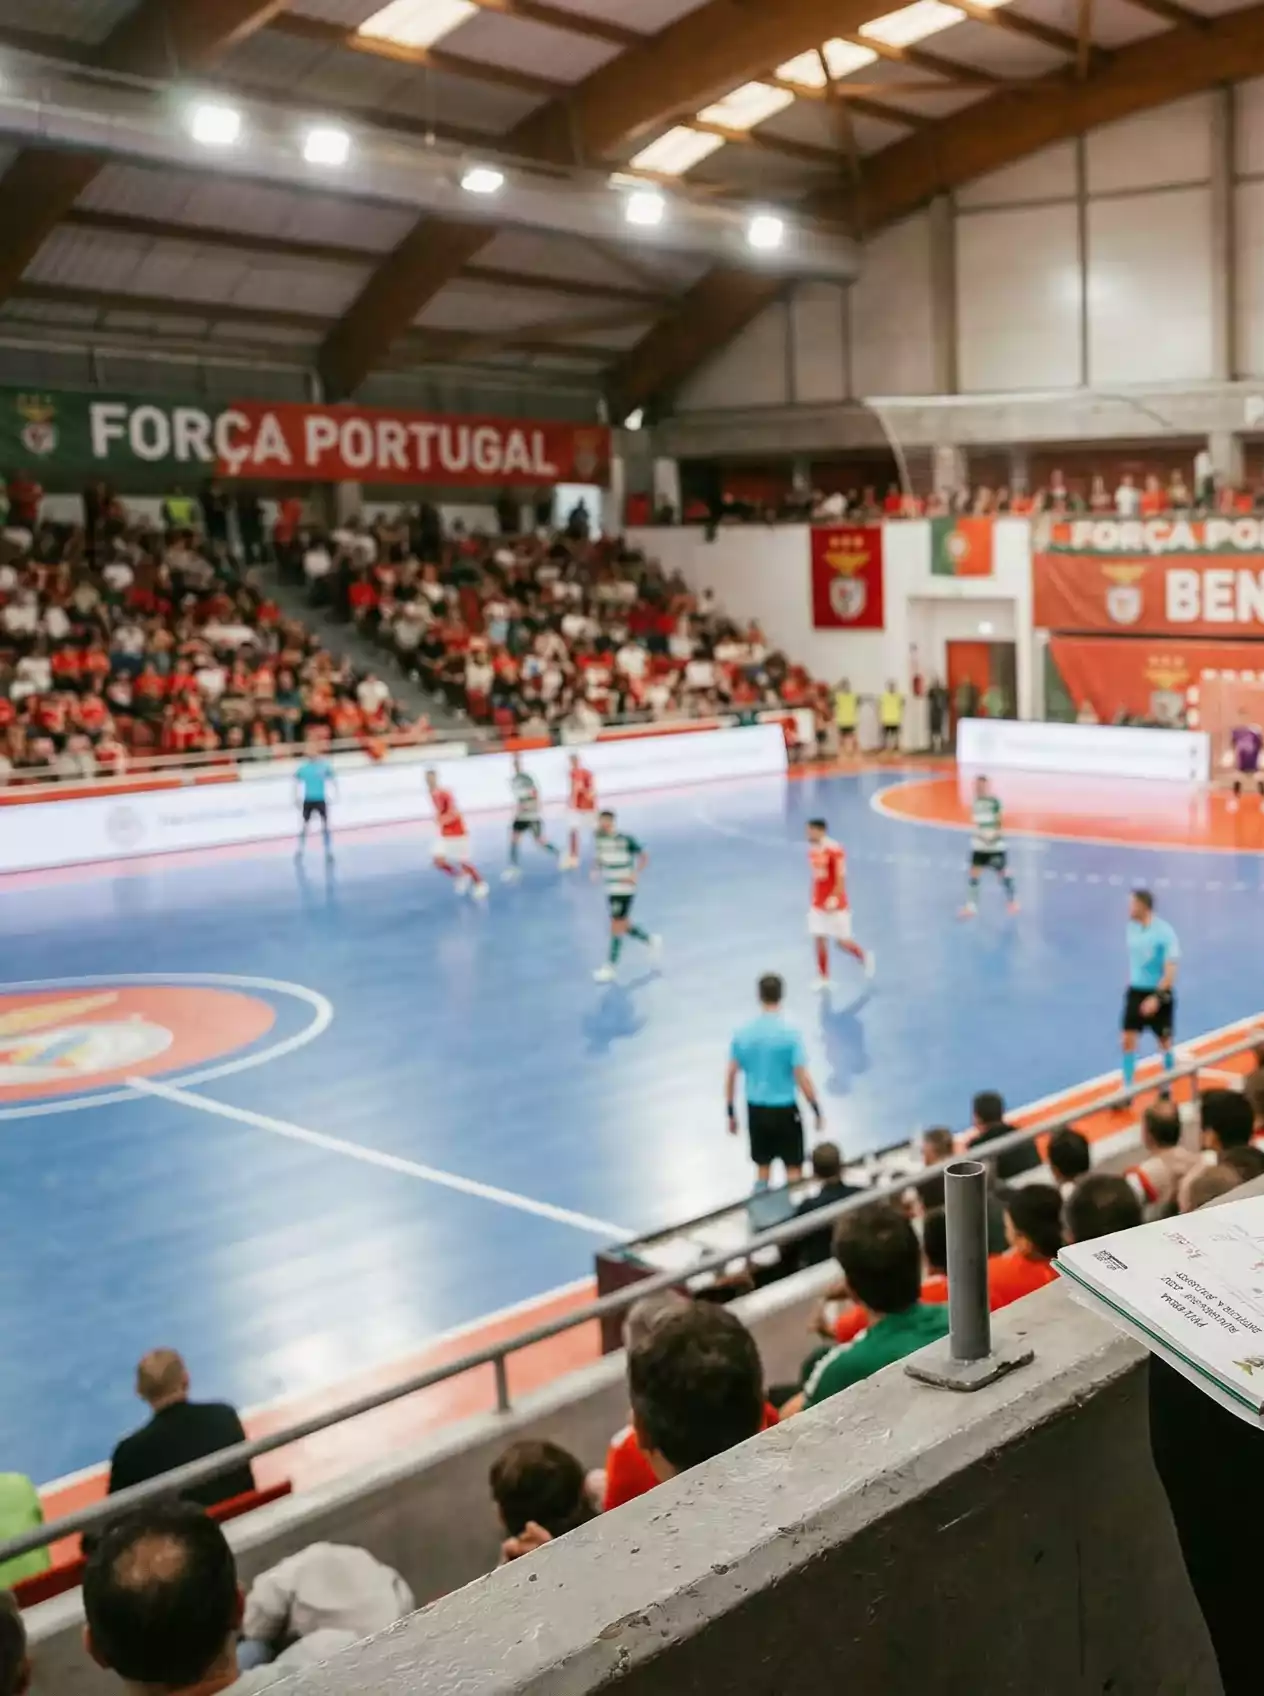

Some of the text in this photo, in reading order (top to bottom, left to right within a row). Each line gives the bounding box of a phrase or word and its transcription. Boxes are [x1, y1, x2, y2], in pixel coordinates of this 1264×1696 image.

[89, 401, 559, 476] FORÇA PORTUGAL
[1070, 519, 1197, 554] FORÇA
